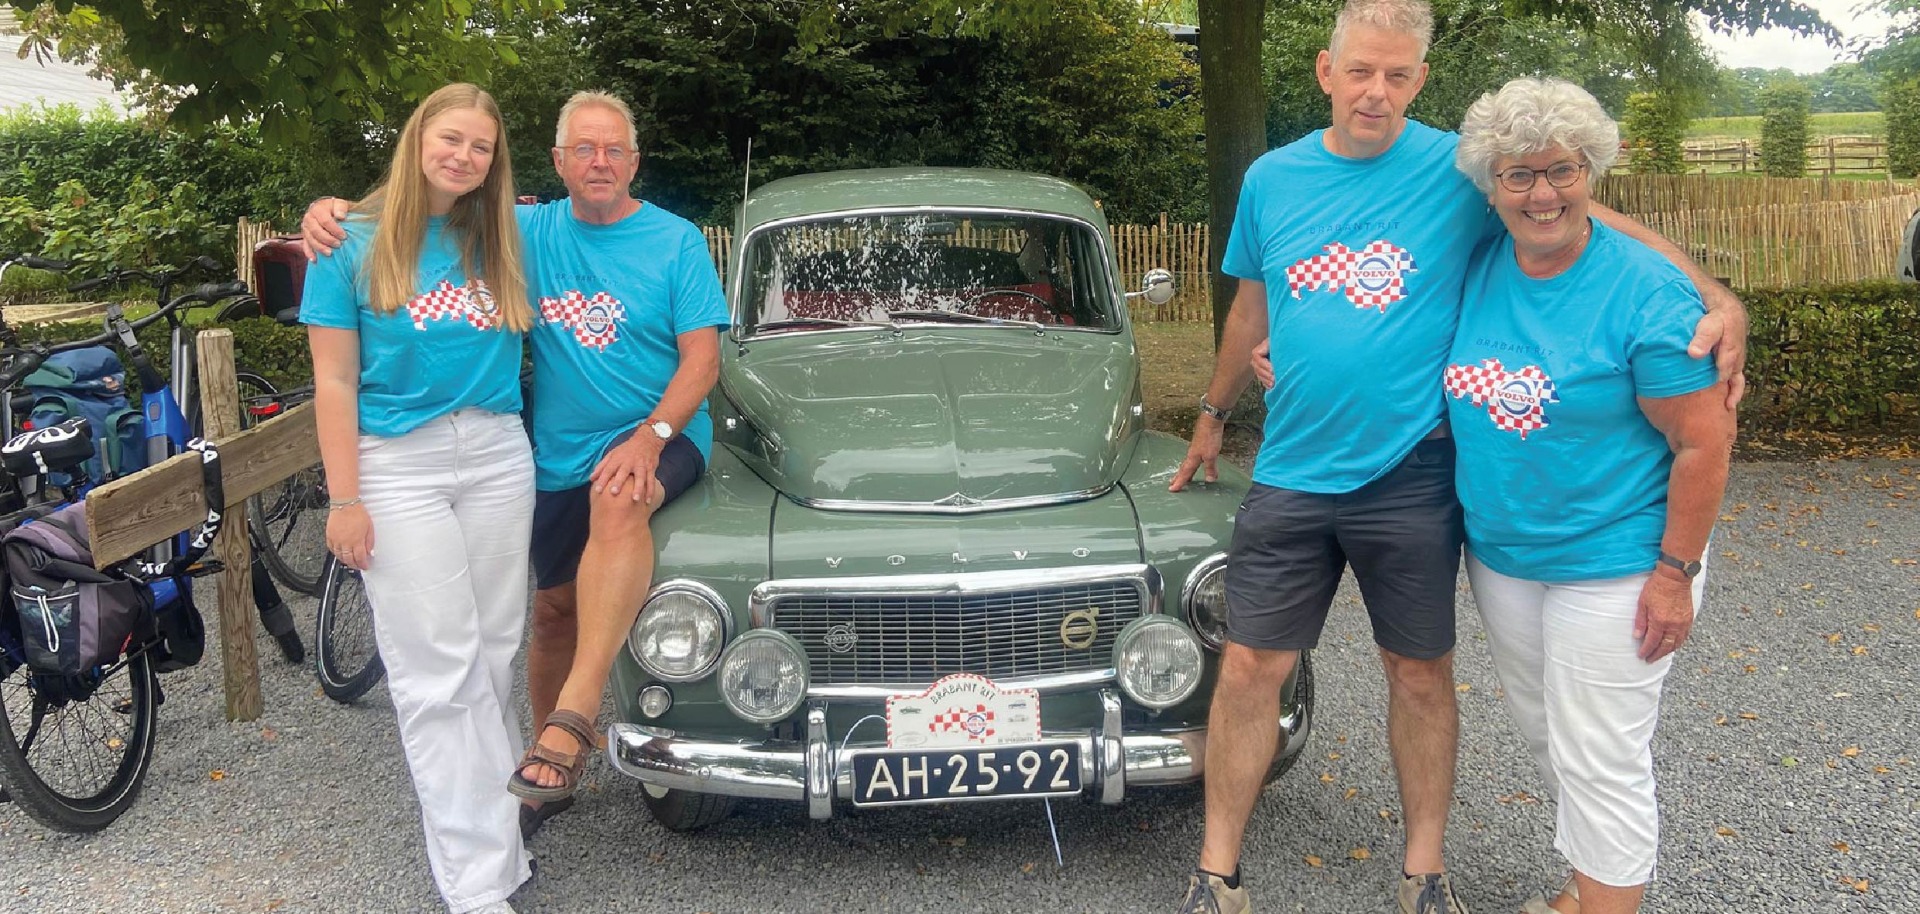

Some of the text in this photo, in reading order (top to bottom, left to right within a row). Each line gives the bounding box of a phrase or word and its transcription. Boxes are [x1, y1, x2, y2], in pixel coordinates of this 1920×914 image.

[1308, 221, 1401, 235] BRABANT RIT
[1353, 270, 1396, 278] VOLVO
[583, 315, 610, 323] VOLVO
[1475, 338, 1555, 357] BRABANT RIT
[1496, 389, 1536, 404] VOLVO
[826, 548, 1091, 568] VOLVO
[930, 682, 996, 704] BRABANT RIT
